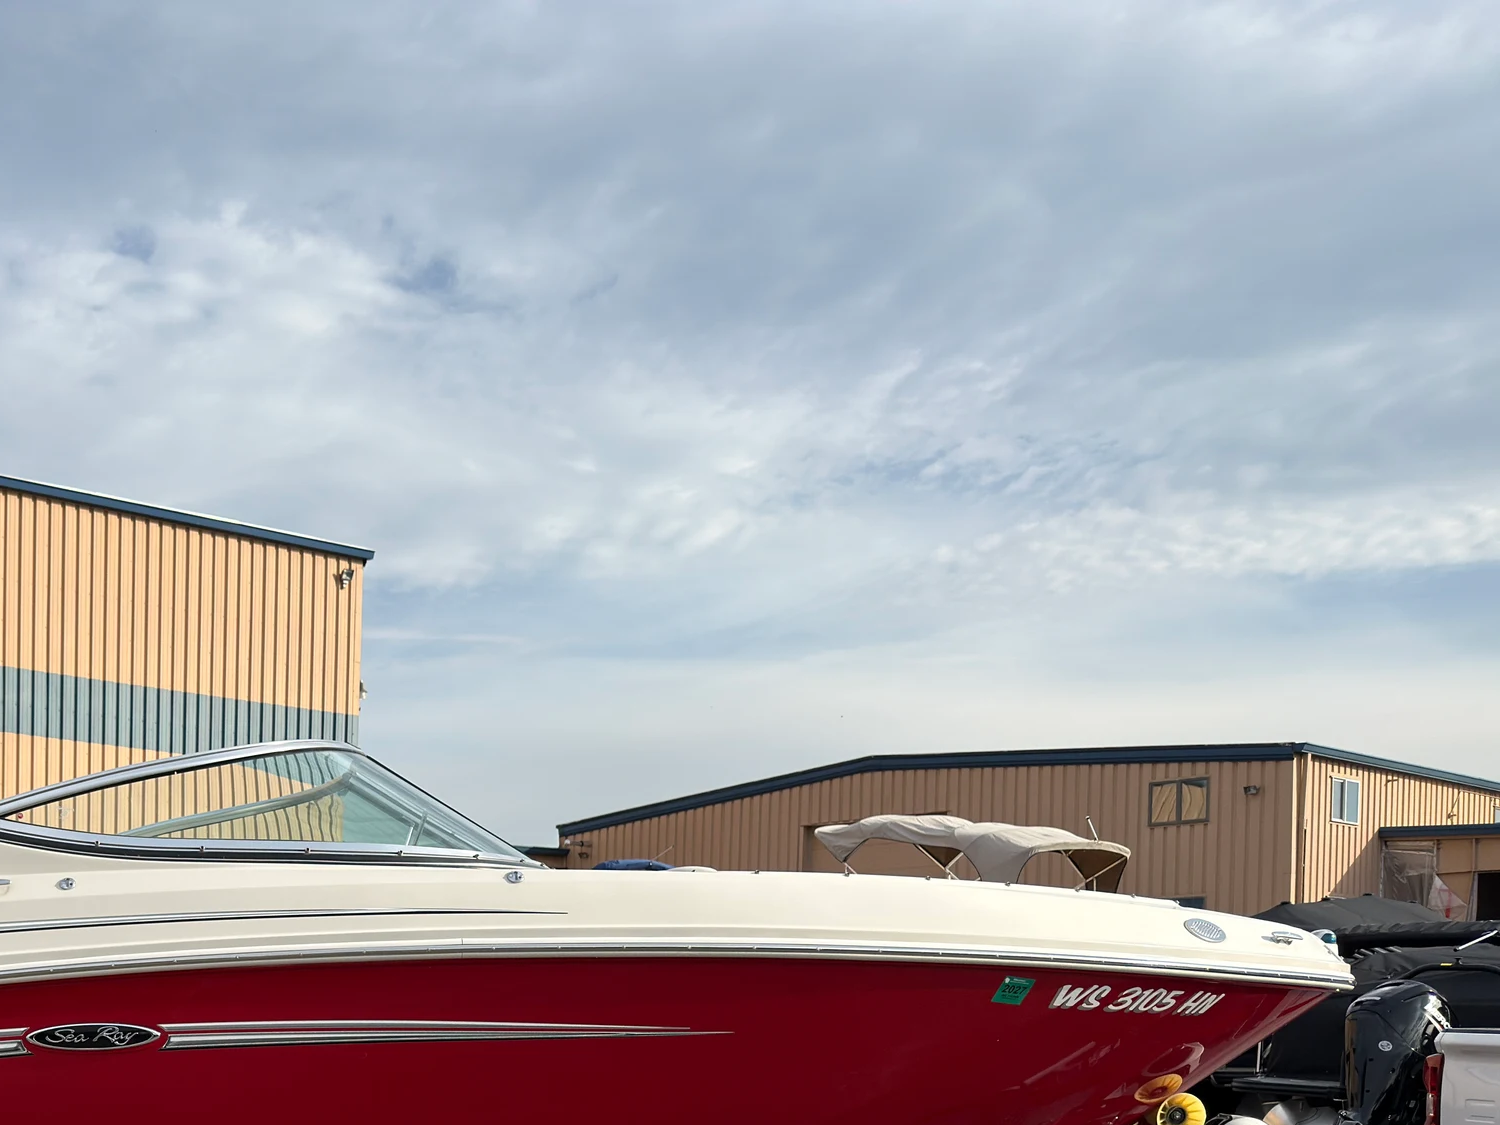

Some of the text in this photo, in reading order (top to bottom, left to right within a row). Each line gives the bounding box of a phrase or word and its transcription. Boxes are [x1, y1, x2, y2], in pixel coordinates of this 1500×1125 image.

[1001, 984, 1028, 995] 2027
[1050, 984, 1225, 1015] WS 3105 HN
[45, 1026, 139, 1046] Sea Ray
